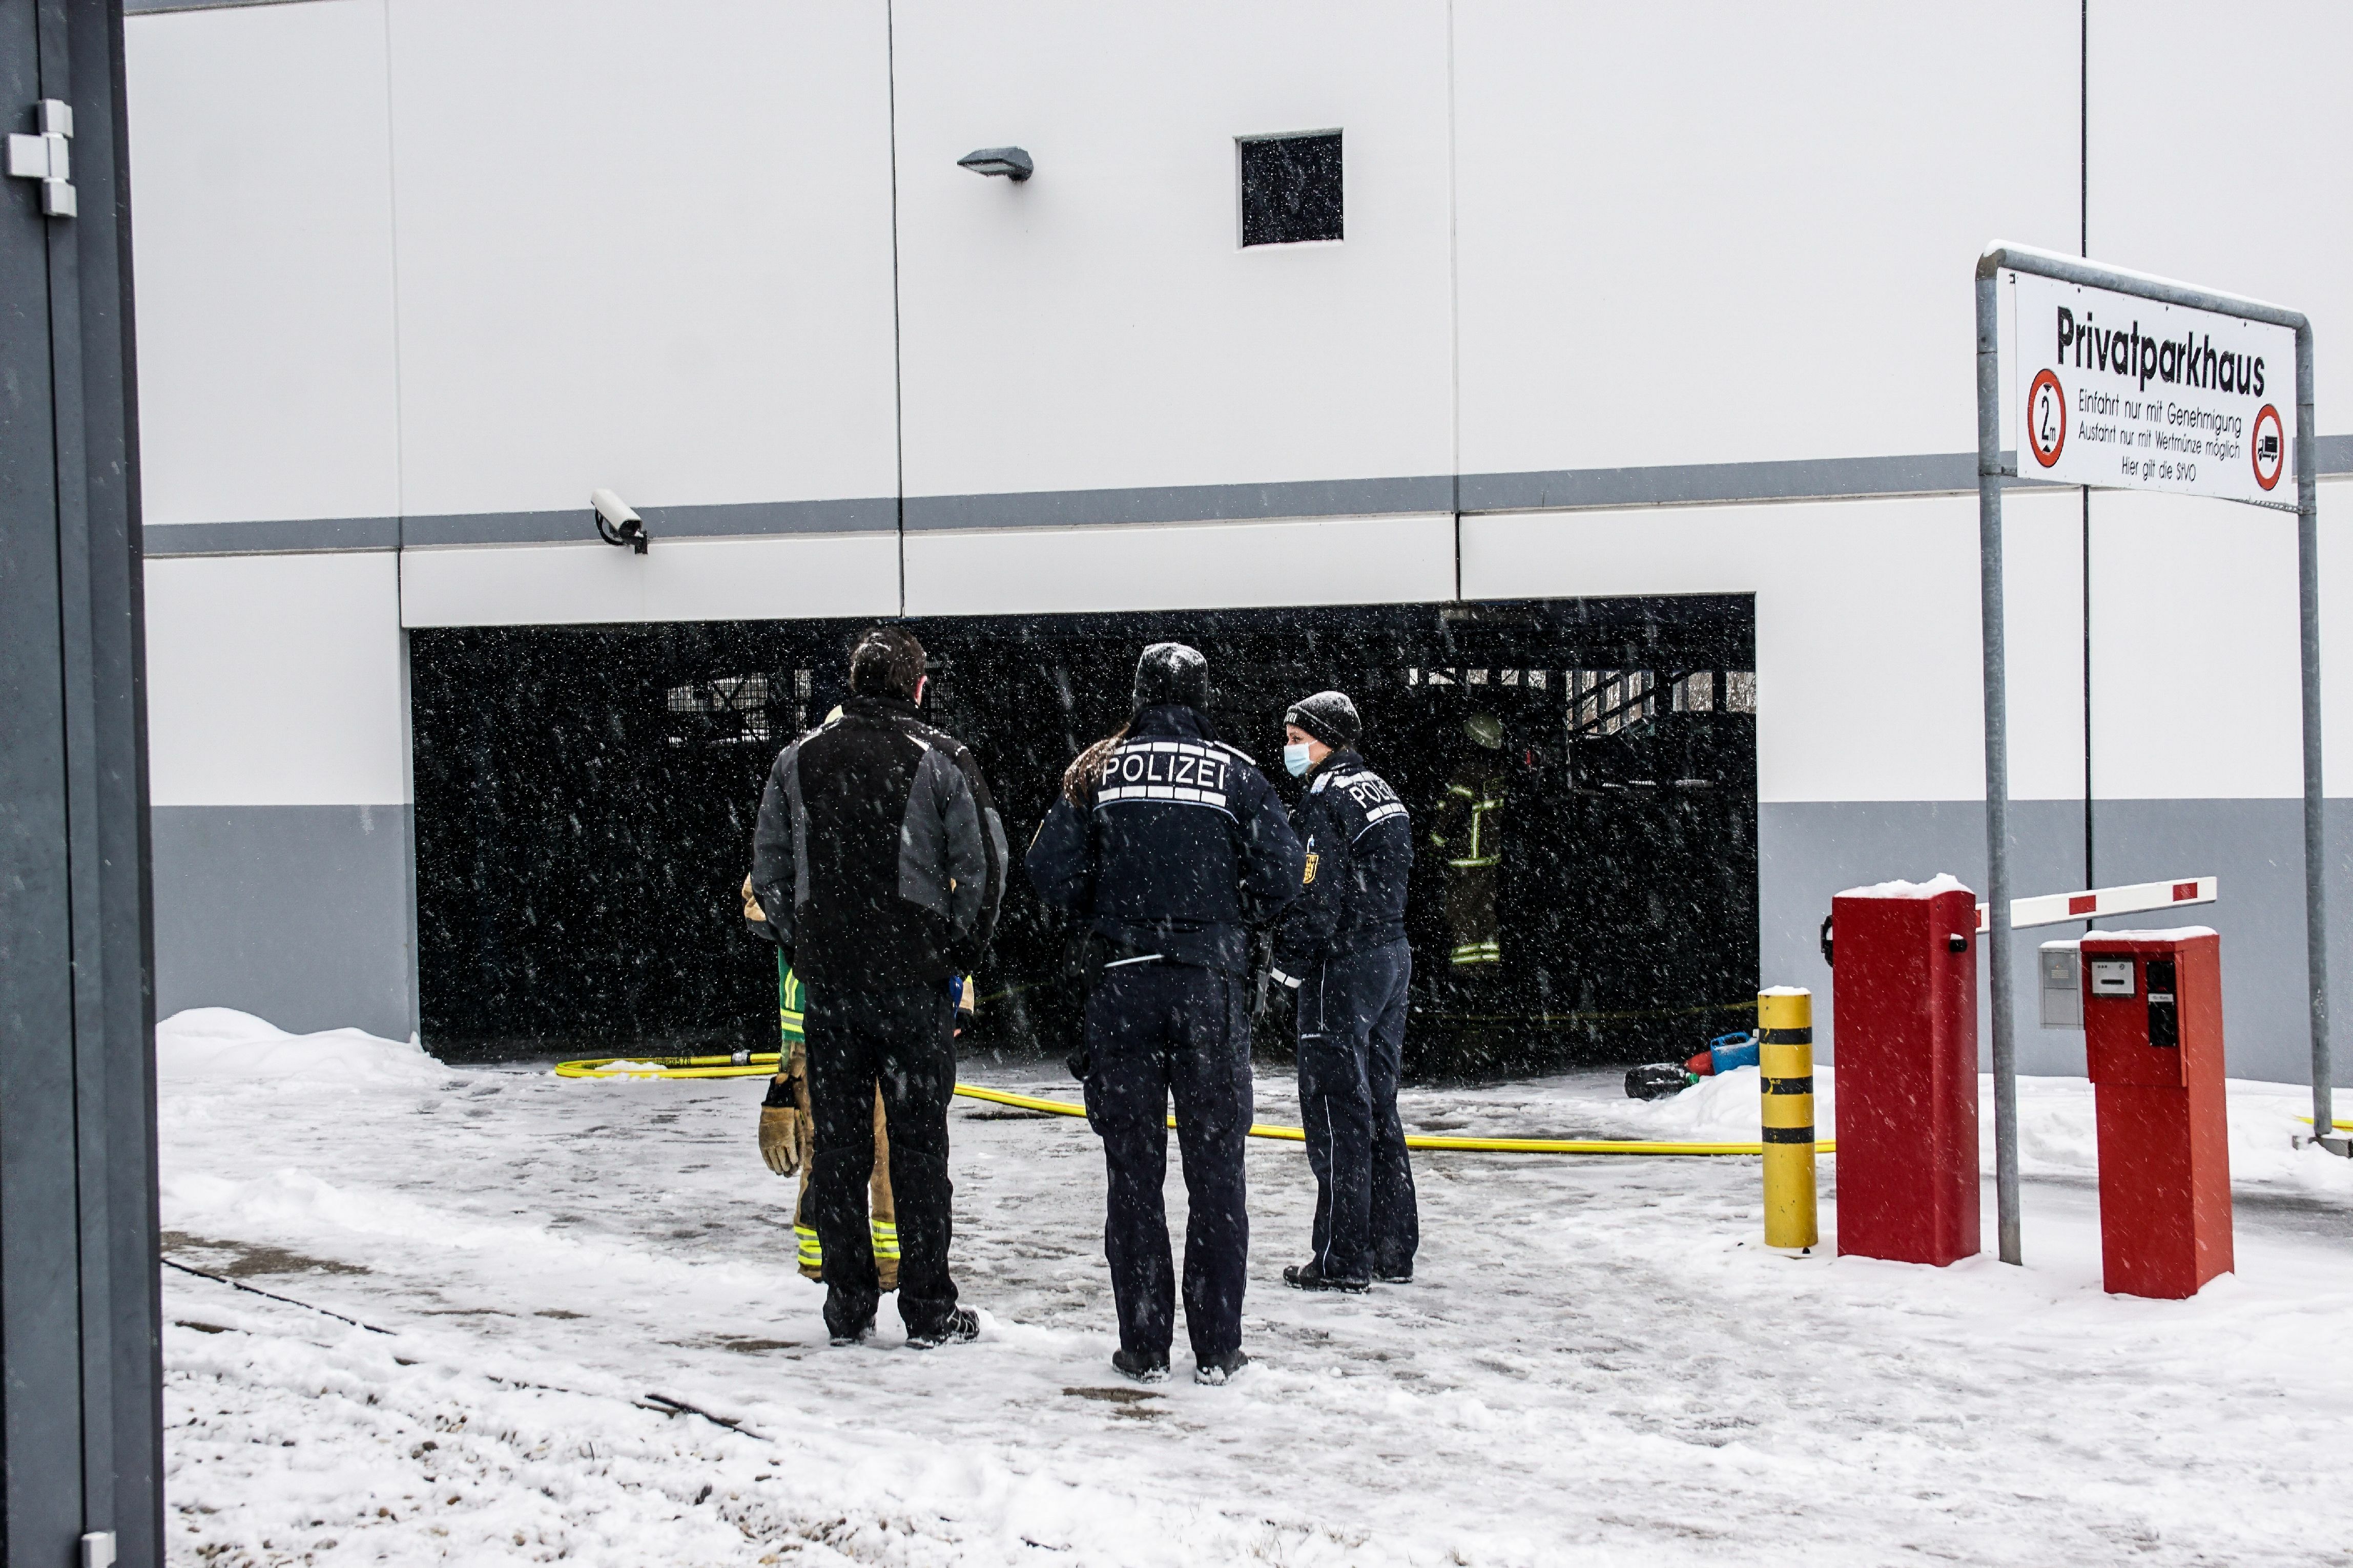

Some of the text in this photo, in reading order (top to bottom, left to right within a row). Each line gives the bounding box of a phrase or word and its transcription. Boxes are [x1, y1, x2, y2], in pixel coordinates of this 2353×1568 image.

[2057, 305, 2265, 398] Privatparkhaus
[2078, 388, 2242, 439] Einfahrt nur mit Genehmigung
[2078, 420, 2240, 462] Ausfahrt nur mit Wertmünze möglich
[2121, 455, 2196, 483] Hier gilt die StVO
[1102, 754, 1225, 790] POLIZEI
